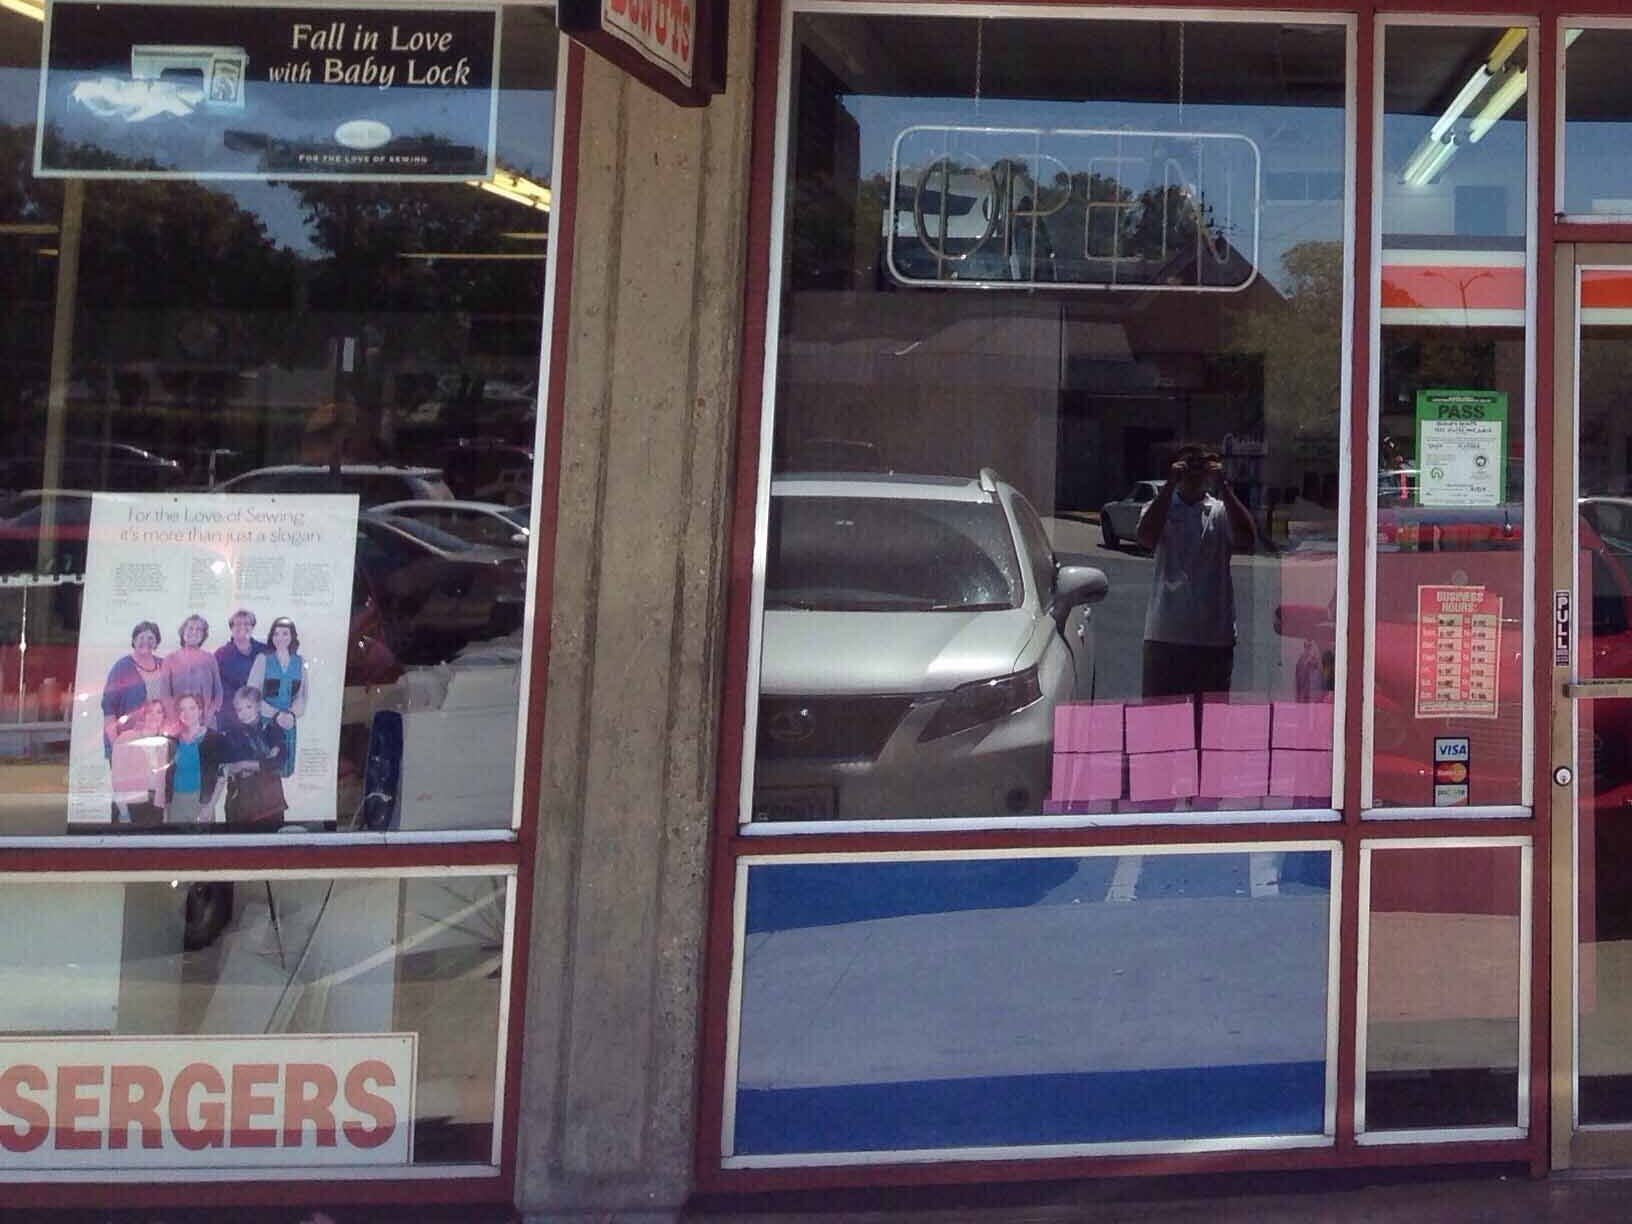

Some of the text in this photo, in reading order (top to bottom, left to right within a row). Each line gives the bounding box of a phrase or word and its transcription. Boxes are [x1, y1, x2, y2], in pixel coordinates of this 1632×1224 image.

[292, 22, 453, 53] Fall in Love
[269, 55, 471, 91] with Baby Lock
[299, 154, 429, 164] FOR THE LOVE OF SEWING
[913, 152, 1232, 265] OPEN
[1438, 404, 1485, 419] PASS
[127, 506, 305, 526] For the Love of Sewing
[143, 530, 185, 543] more
[188, 527, 223, 543] than
[224, 529, 253, 546] just
[269, 527, 322, 546] slogan
[1556, 596, 1569, 649] PULL
[1440, 743, 1467, 756] VISA
[0, 1060, 397, 1153] SERGERS
